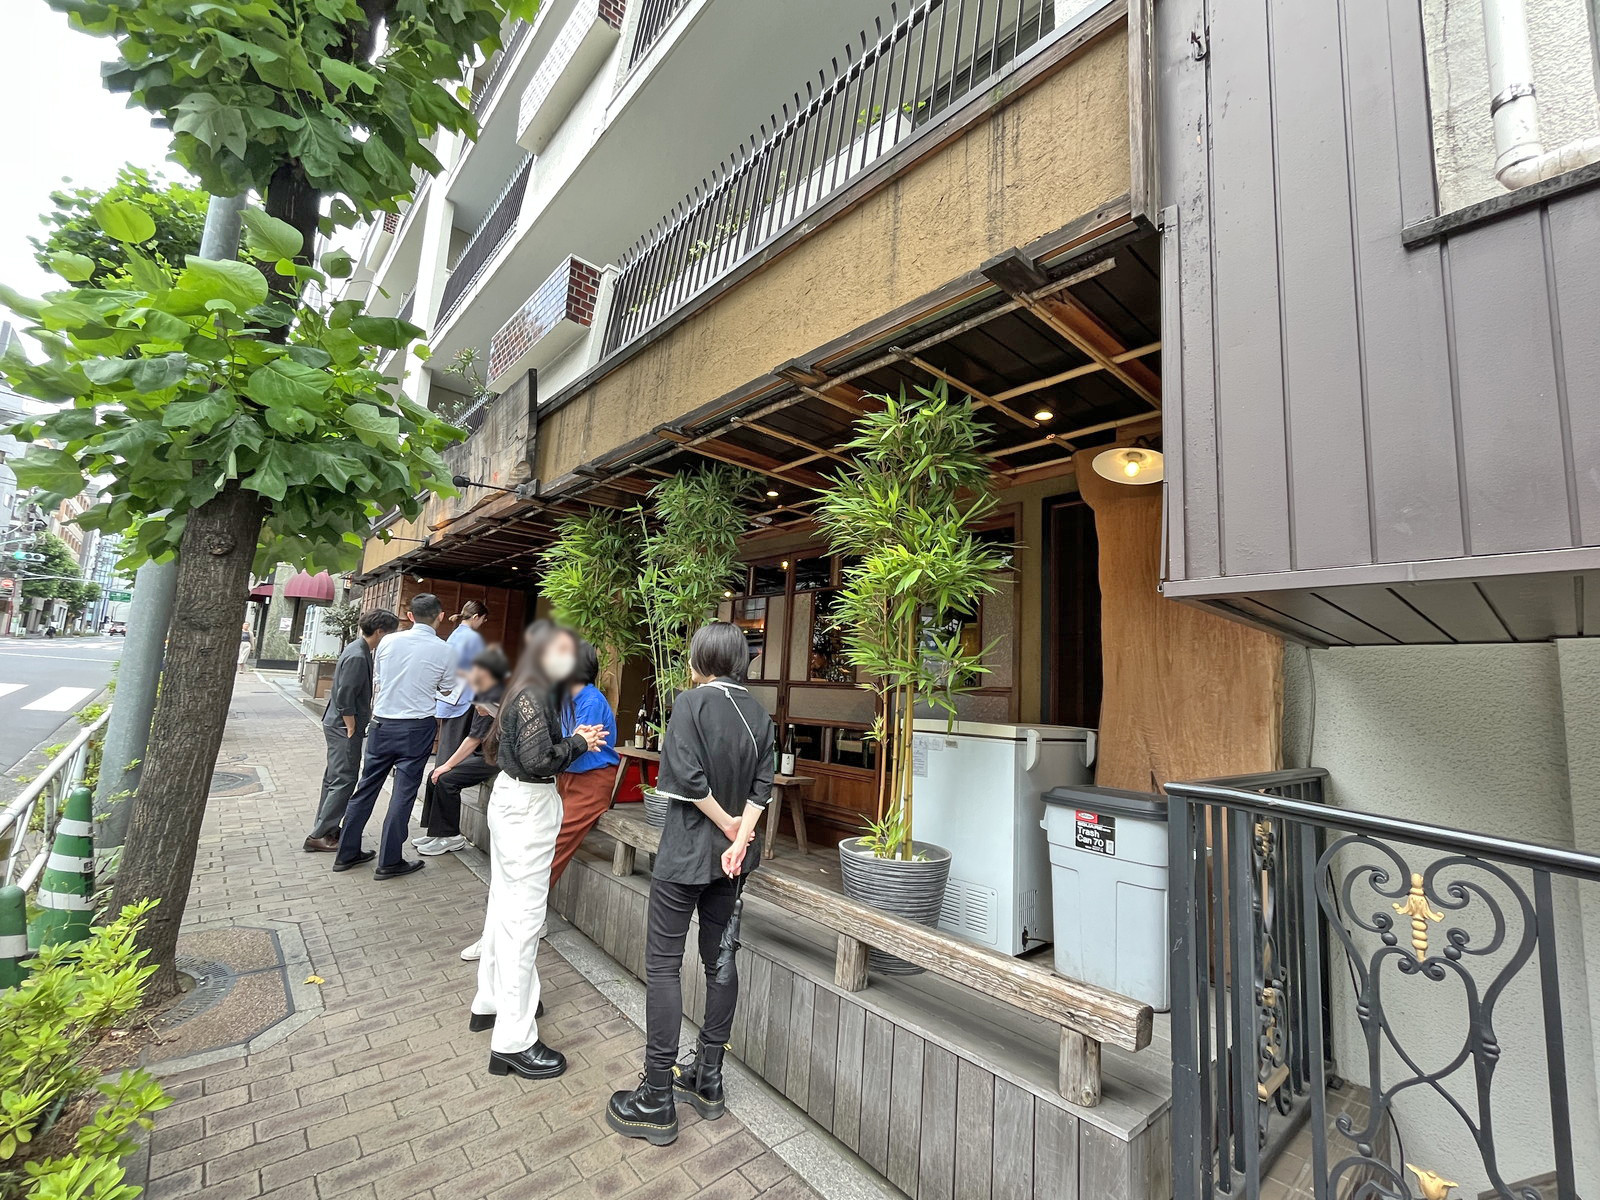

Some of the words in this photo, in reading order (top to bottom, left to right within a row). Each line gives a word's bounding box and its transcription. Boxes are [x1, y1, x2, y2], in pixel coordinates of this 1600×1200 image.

[1077, 826, 1100, 838] Trash
[1077, 834, 1092, 844] Can
[1093, 838, 1104, 847] 70
